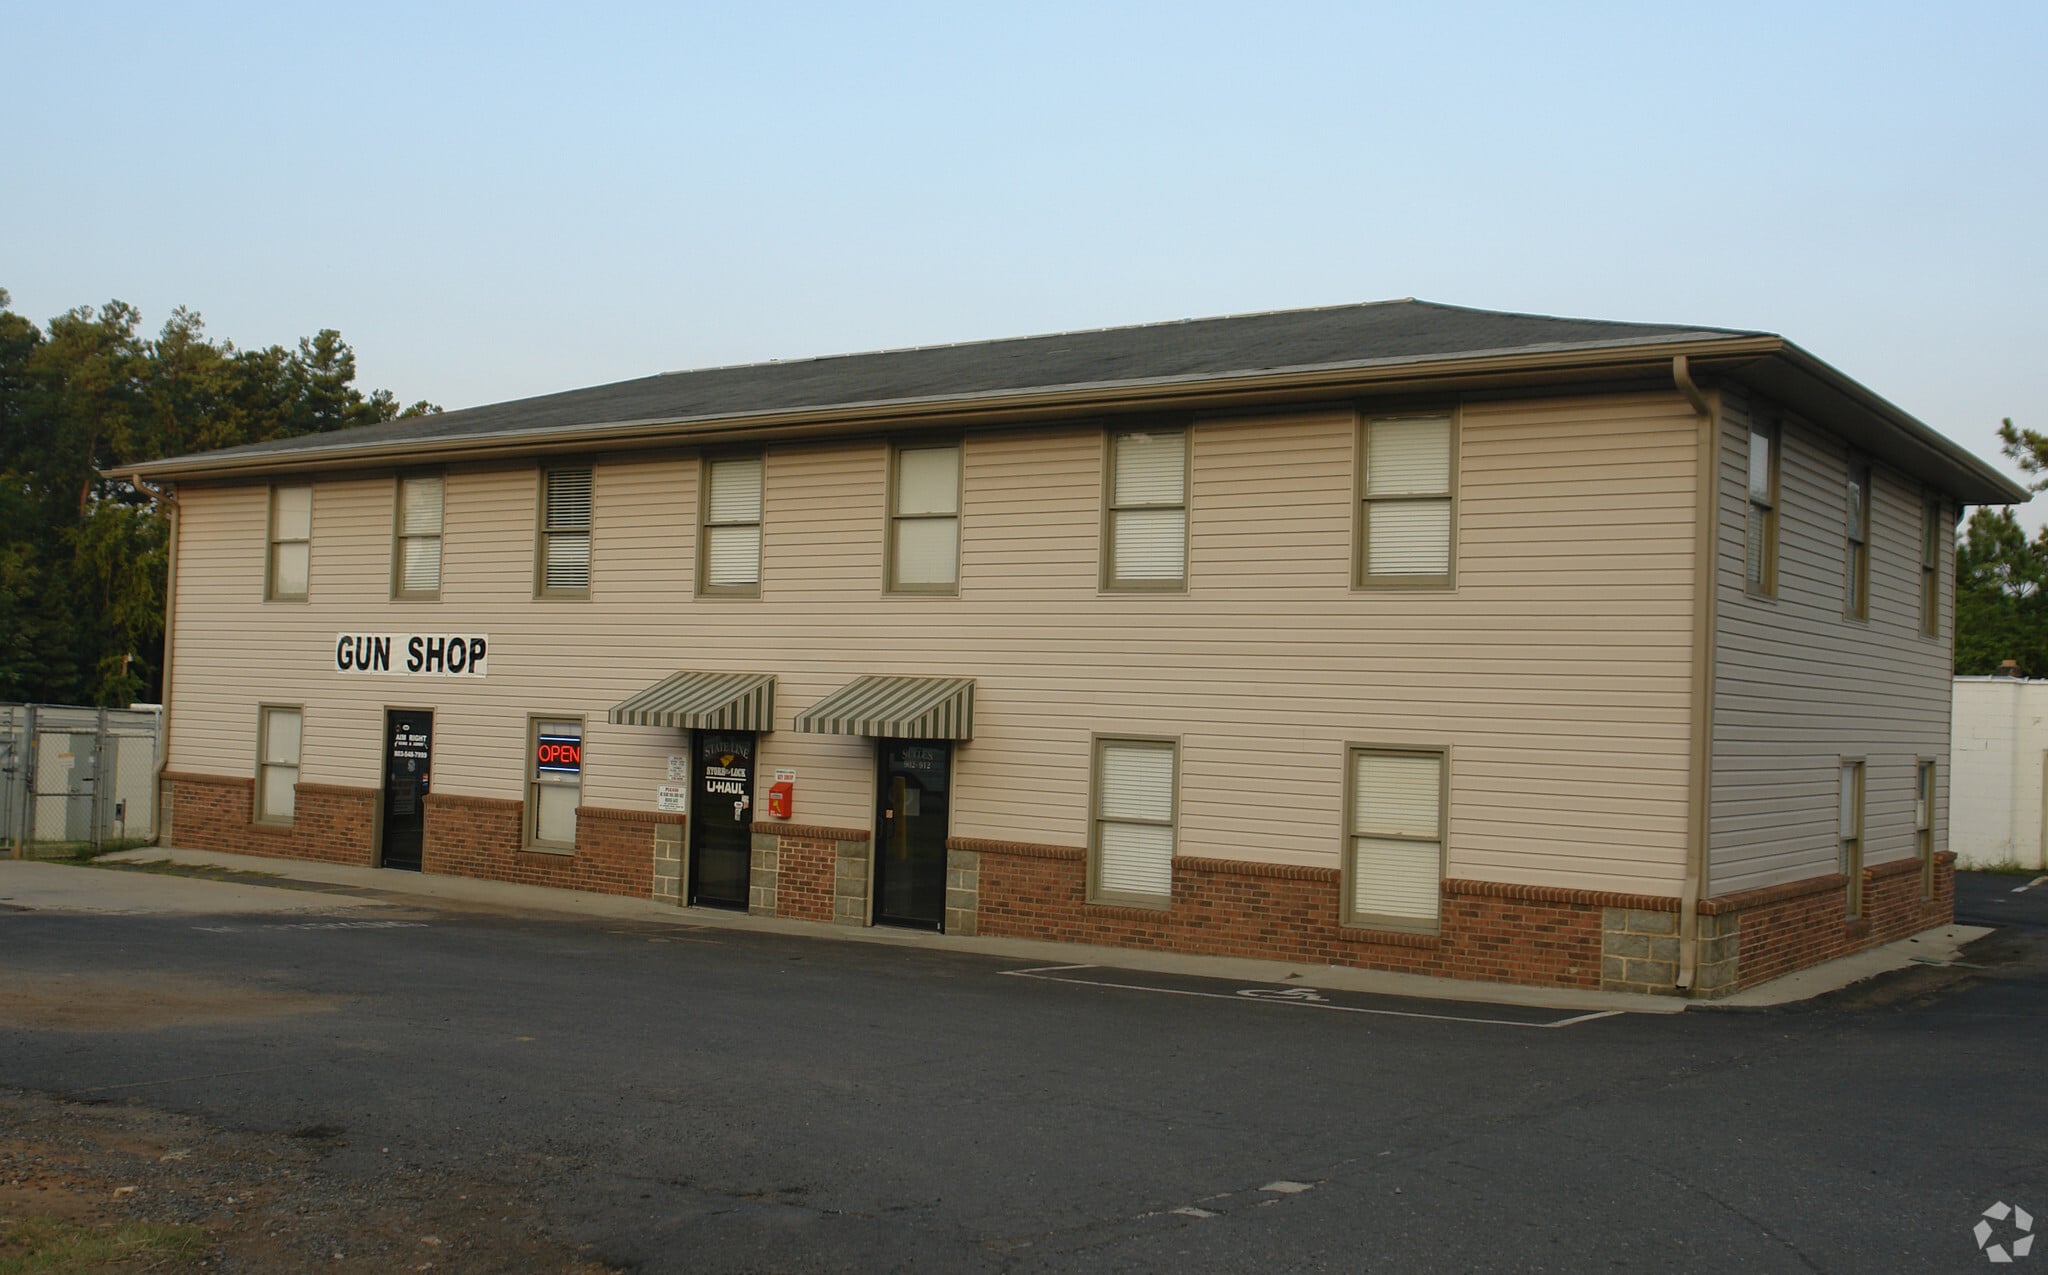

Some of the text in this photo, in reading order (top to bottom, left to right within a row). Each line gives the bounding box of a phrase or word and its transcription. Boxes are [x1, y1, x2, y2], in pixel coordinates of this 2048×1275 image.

[337, 635, 486, 673] GUN SHOP
[408, 734, 427, 742] RIGHT
[538, 744, 581, 763] OPEN
[704, 742, 749, 760] STATE LINE
[901, 748, 933, 760] SUITES
[706, 780, 744, 795] U-HAUL
